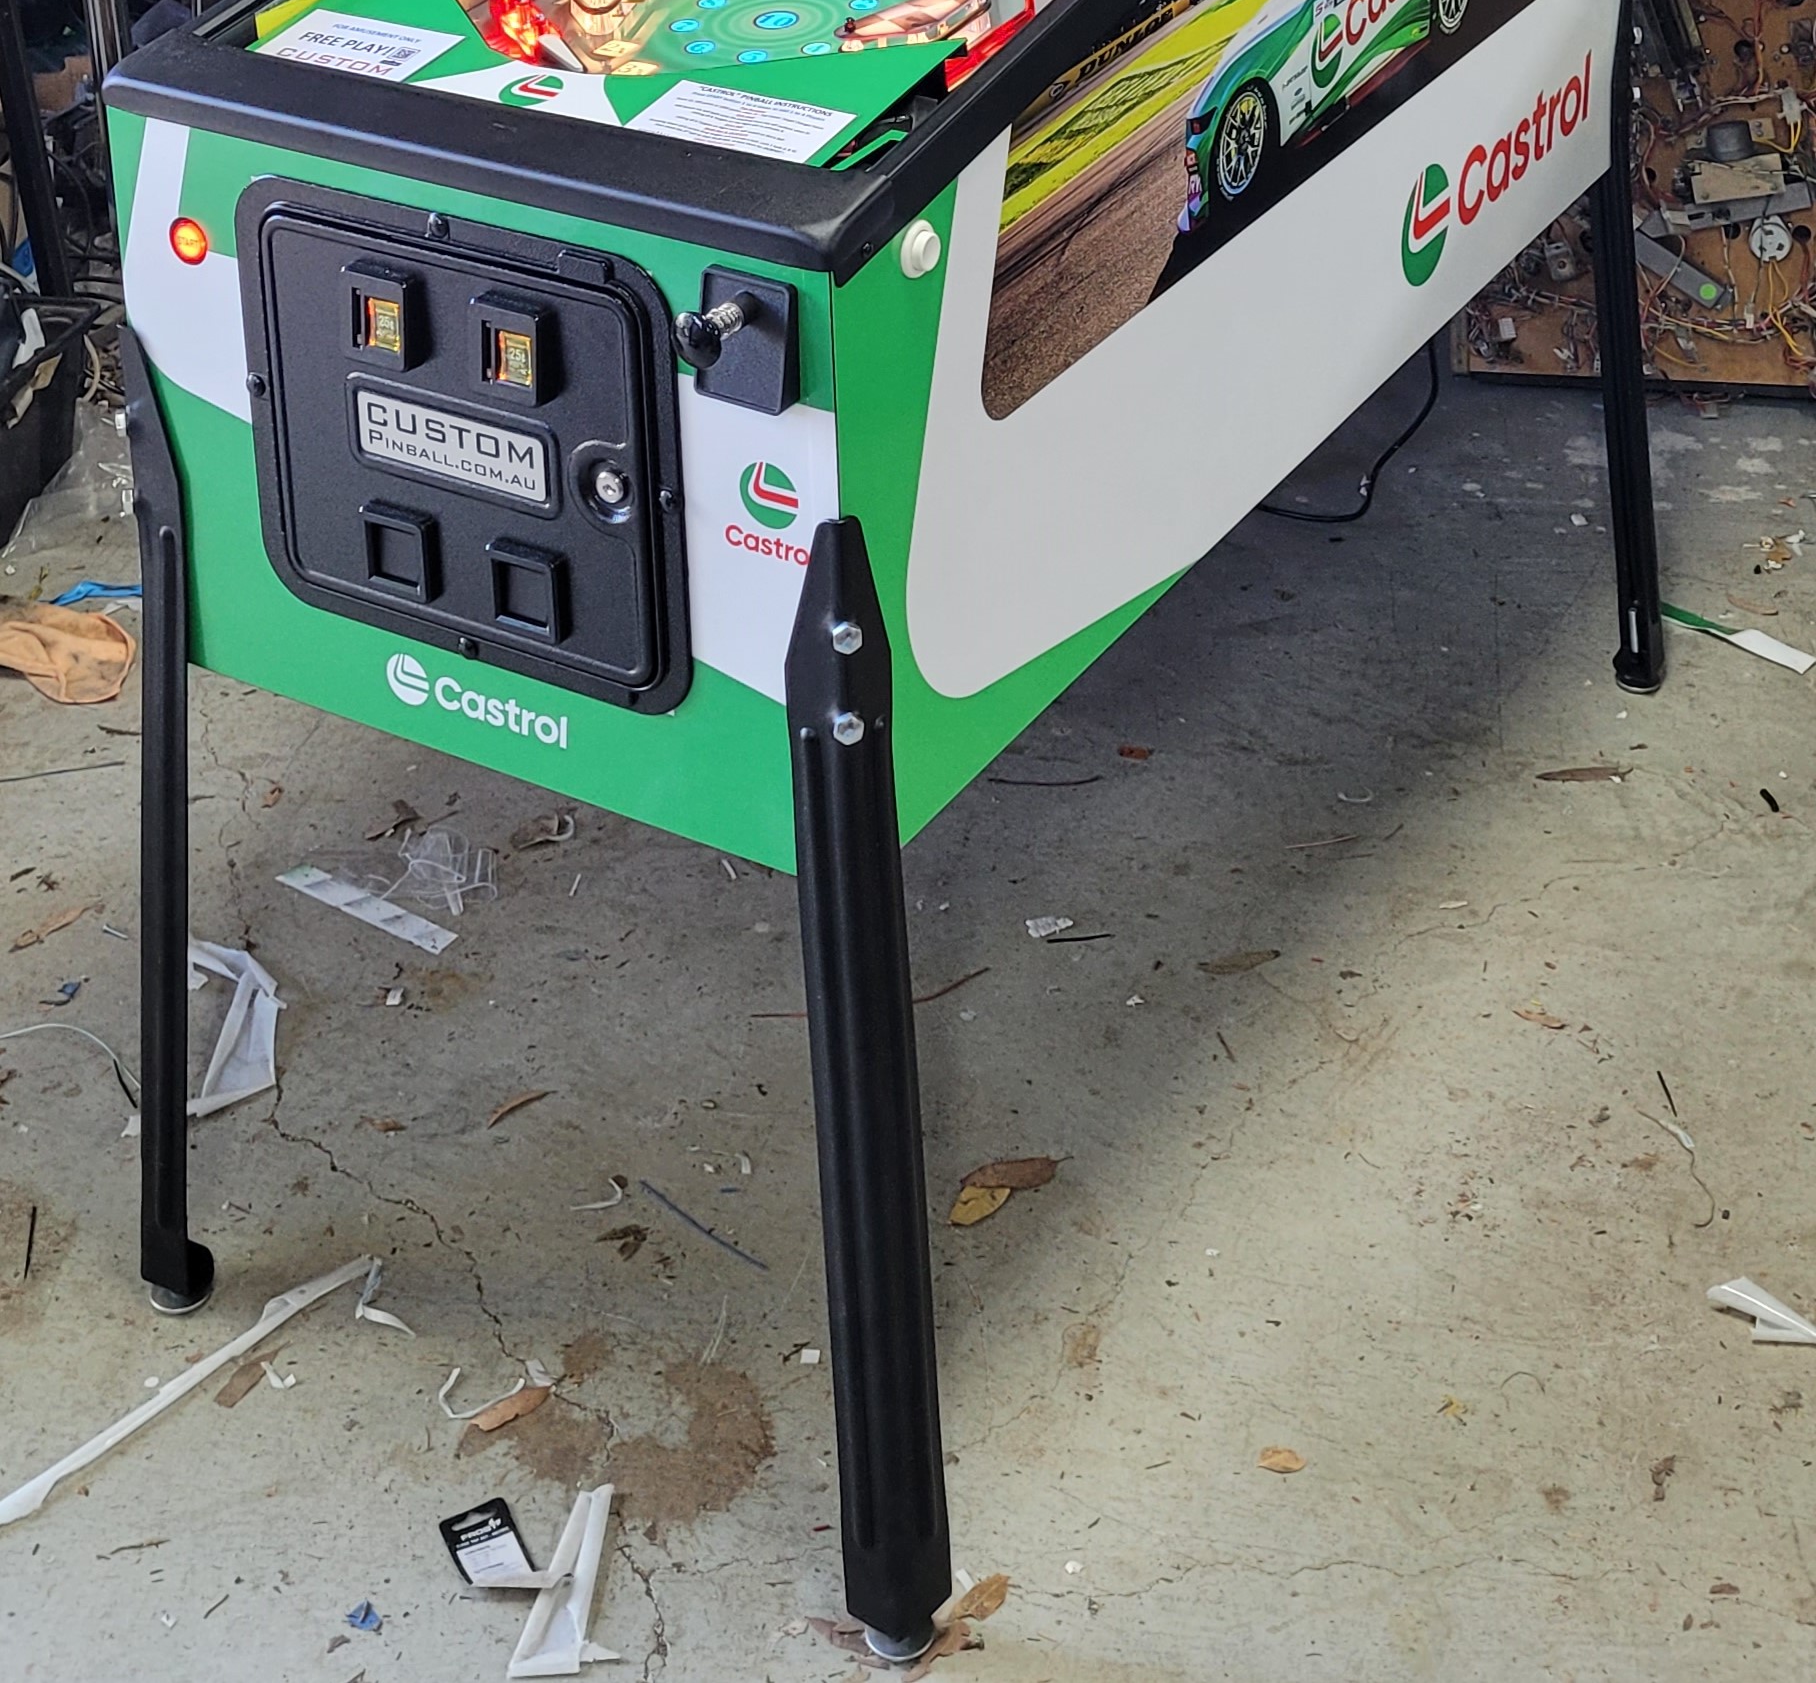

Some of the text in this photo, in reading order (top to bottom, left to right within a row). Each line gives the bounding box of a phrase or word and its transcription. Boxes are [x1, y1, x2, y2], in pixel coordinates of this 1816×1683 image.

[276, 47, 394, 76] CUSTOM
[299, 31, 396, 57] FREE PLAY!
[1078, 7, 1175, 81] DUNLOP
[740, 93, 773, 107] PINBALL
[773, 100, 833, 118] INSTRUCTIONS
[1458, 48, 1592, 225] Castrol
[367, 401, 534, 469] CUSTOM
[368, 428, 536, 491] PINBALL.COM.AU
[725, 524, 811, 565] Castro
[434, 676, 568, 750] Castrol
